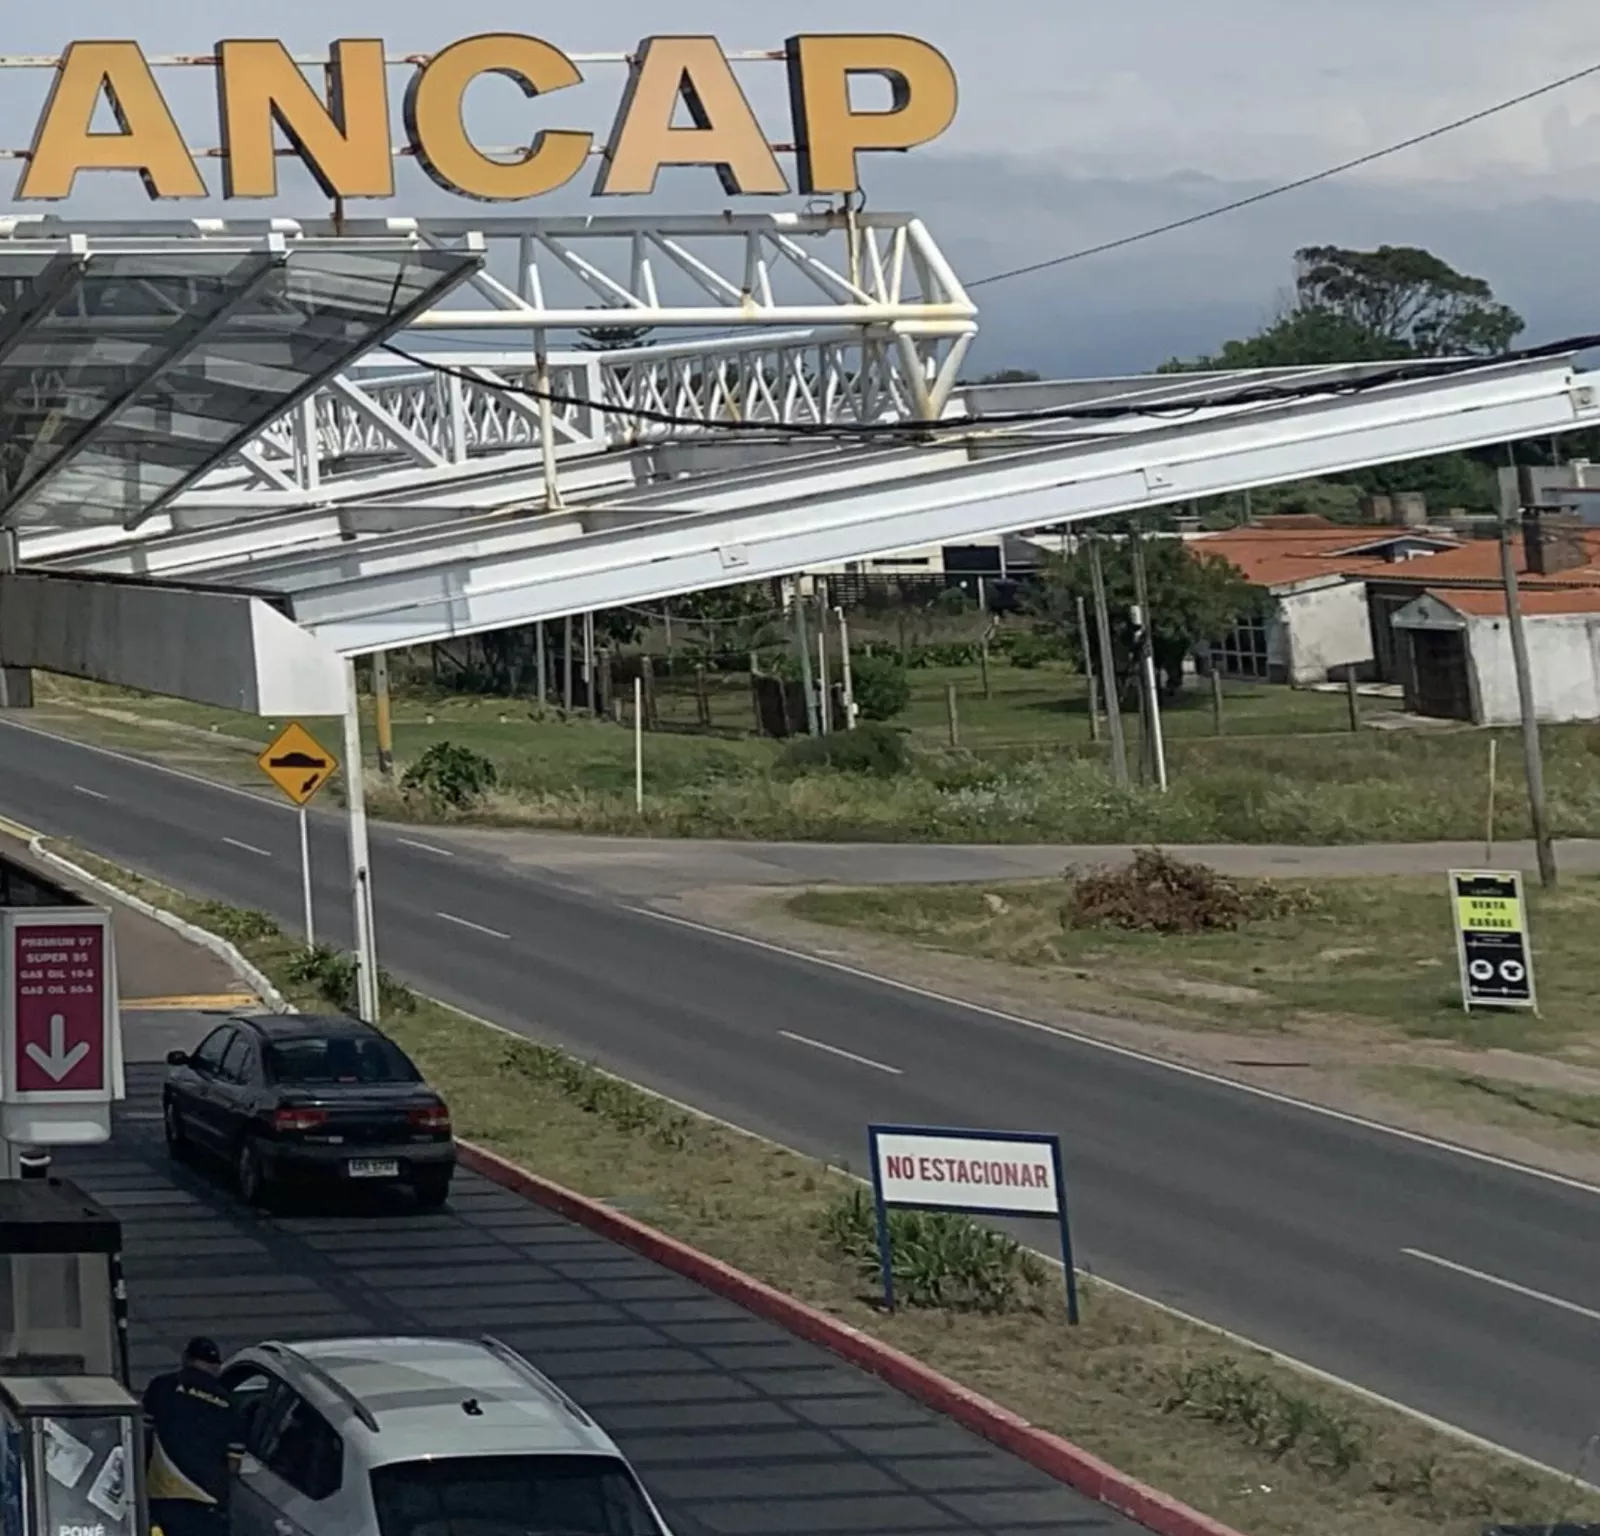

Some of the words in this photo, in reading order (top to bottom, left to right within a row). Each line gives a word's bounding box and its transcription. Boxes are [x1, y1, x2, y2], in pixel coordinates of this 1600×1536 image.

[14, 33, 958, 201] ANCAP
[26, 952, 68, 963] SUPER
[20, 970, 43, 979] GAS
[47, 969, 67, 979] OIL
[20, 986, 43, 995] GAS
[47, 985, 67, 995] OIL
[886, 1155, 914, 1180] NO
[918, 1157, 1048, 1188] ESTACIONAR
